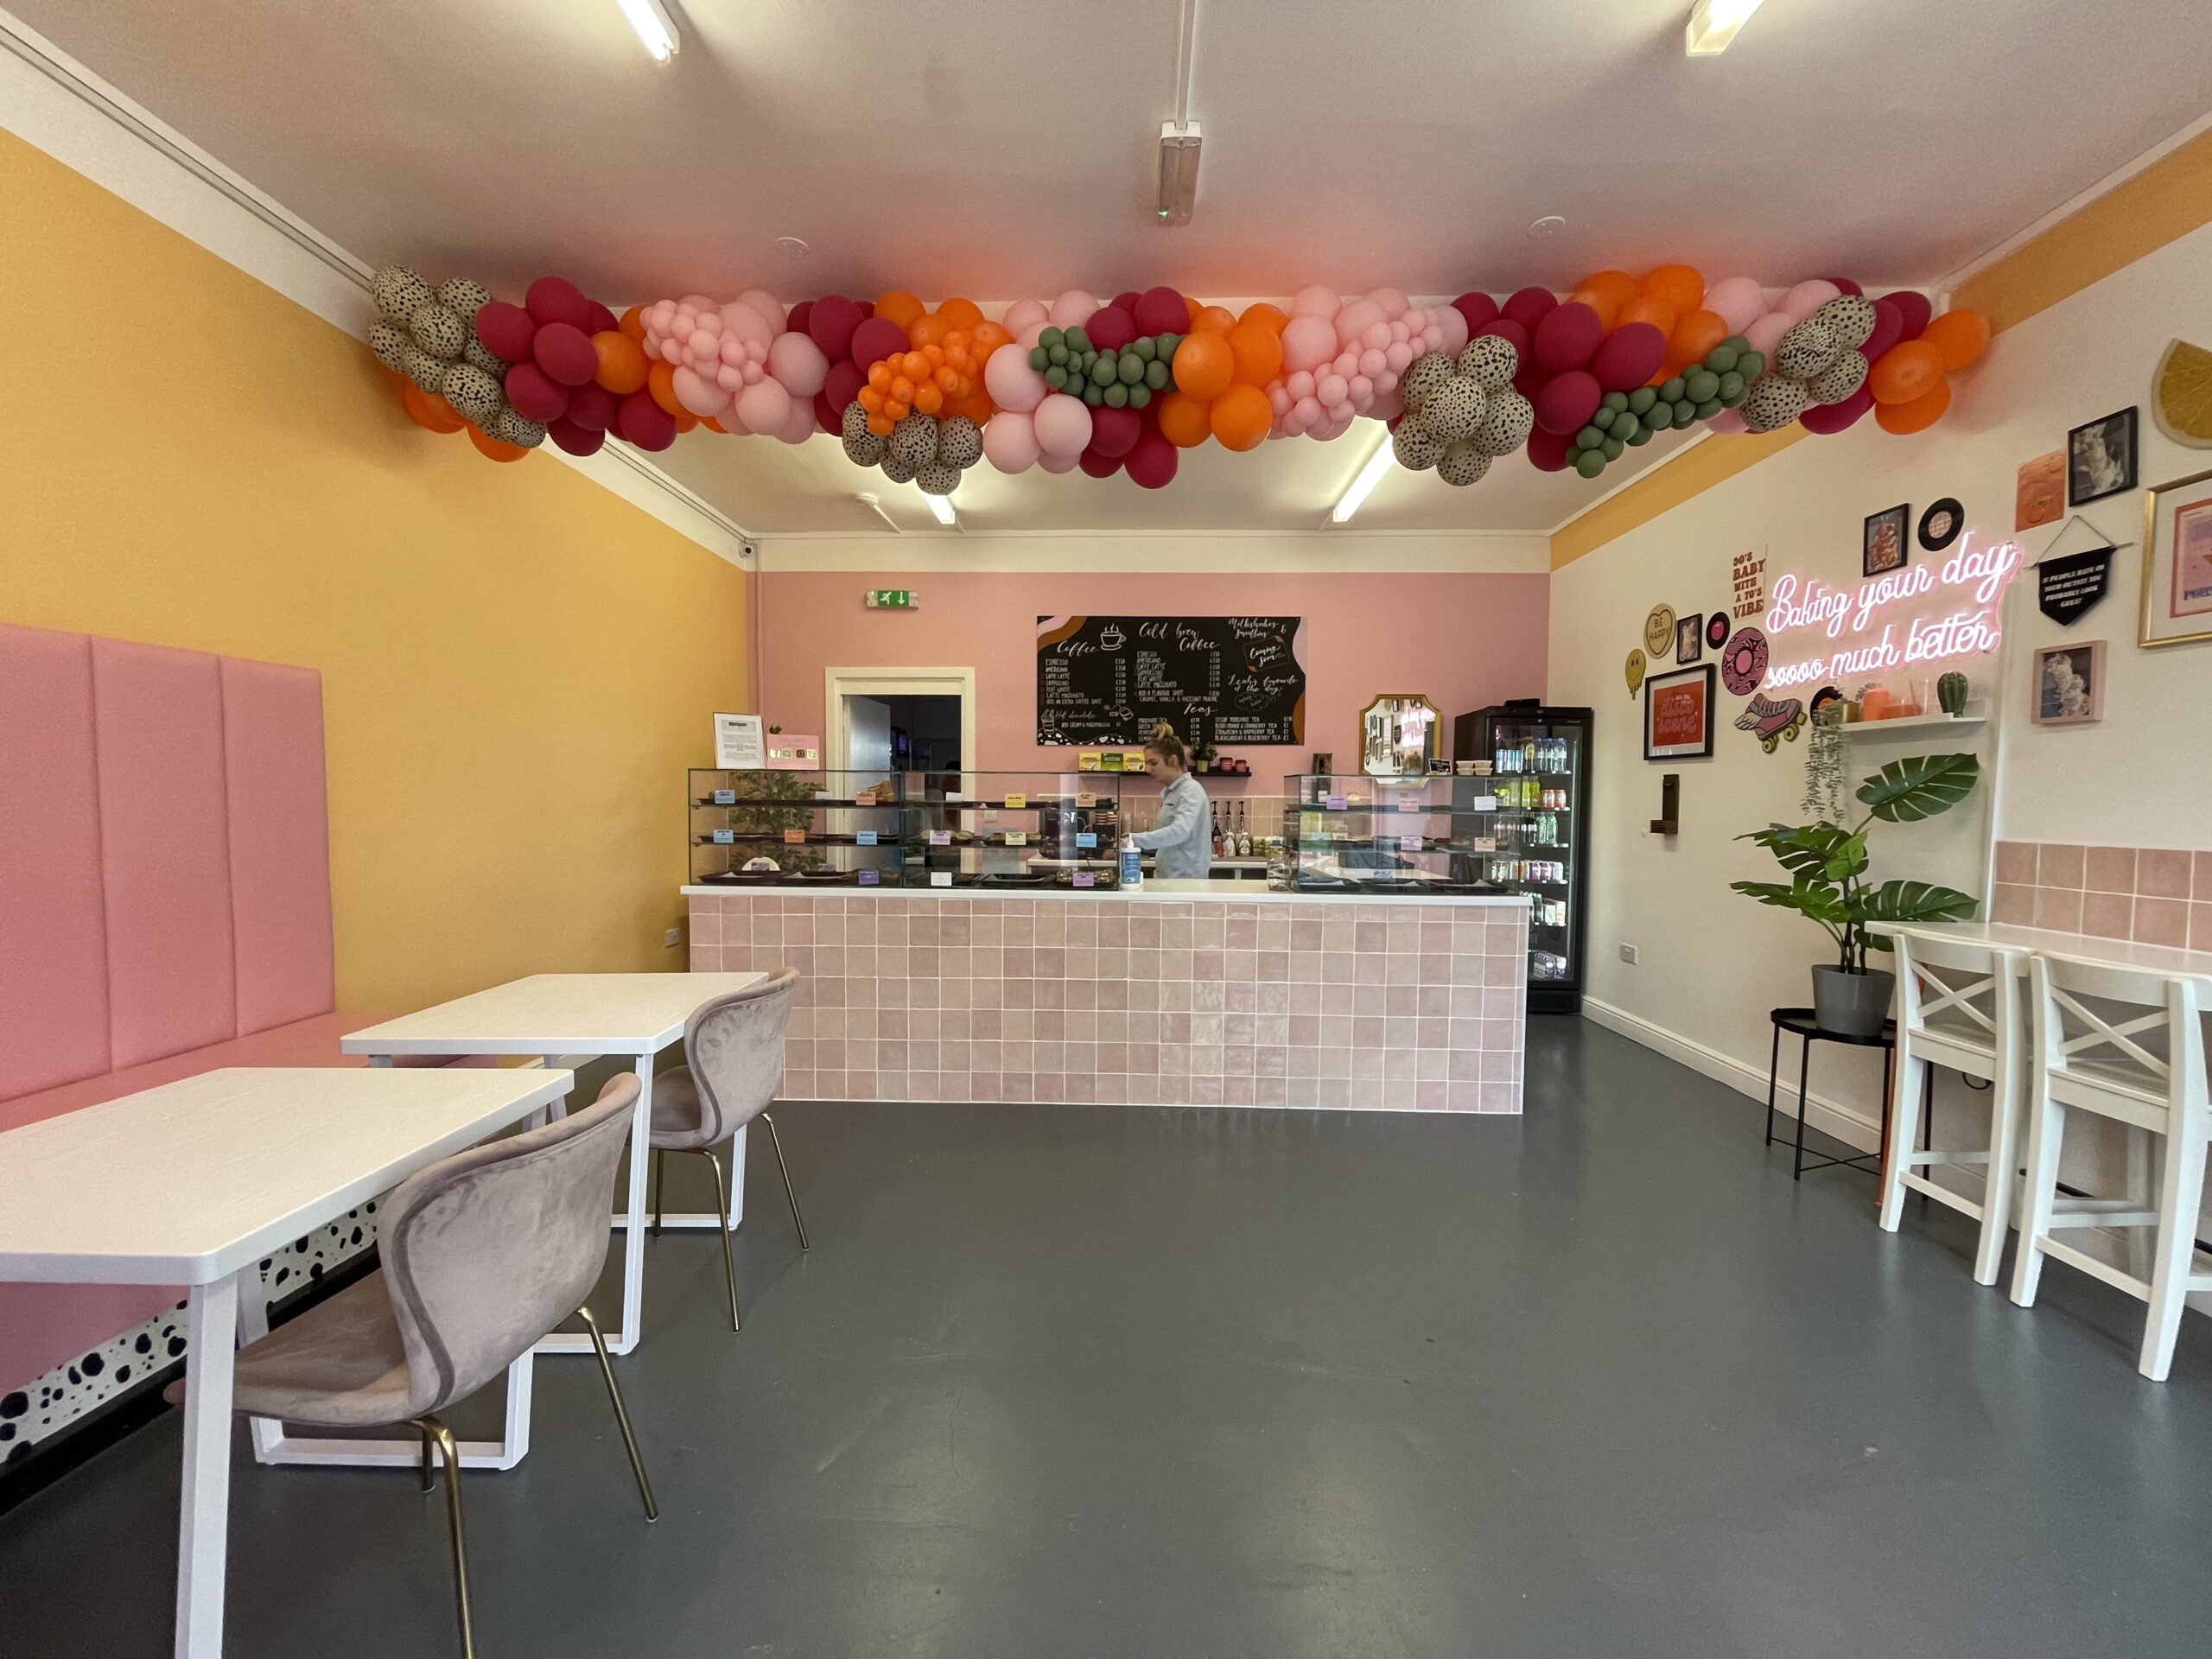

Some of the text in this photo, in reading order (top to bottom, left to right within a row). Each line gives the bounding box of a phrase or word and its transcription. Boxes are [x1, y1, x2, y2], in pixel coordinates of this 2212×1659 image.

[1732, 558, 1766, 581] BABY
[1734, 576, 1757, 592] WITH
[1766, 529, 2018, 638] Baking your day
[1735, 594, 1741, 603] A
[1732, 599, 1764, 619] VIBE
[1139, 621, 1199, 639] Cold brew
[1653, 618, 1663, 628] BE
[1649, 627, 1671, 642] HAPPY
[1057, 639, 1099, 657] Coffee
[1179, 637, 1221, 652] Coffee
[1249, 645, 1281, 659] Coming
[1764, 610, 2002, 690] soooo much better
[1246, 683, 1260, 692] the
[1184, 702, 1218, 716] Teas
